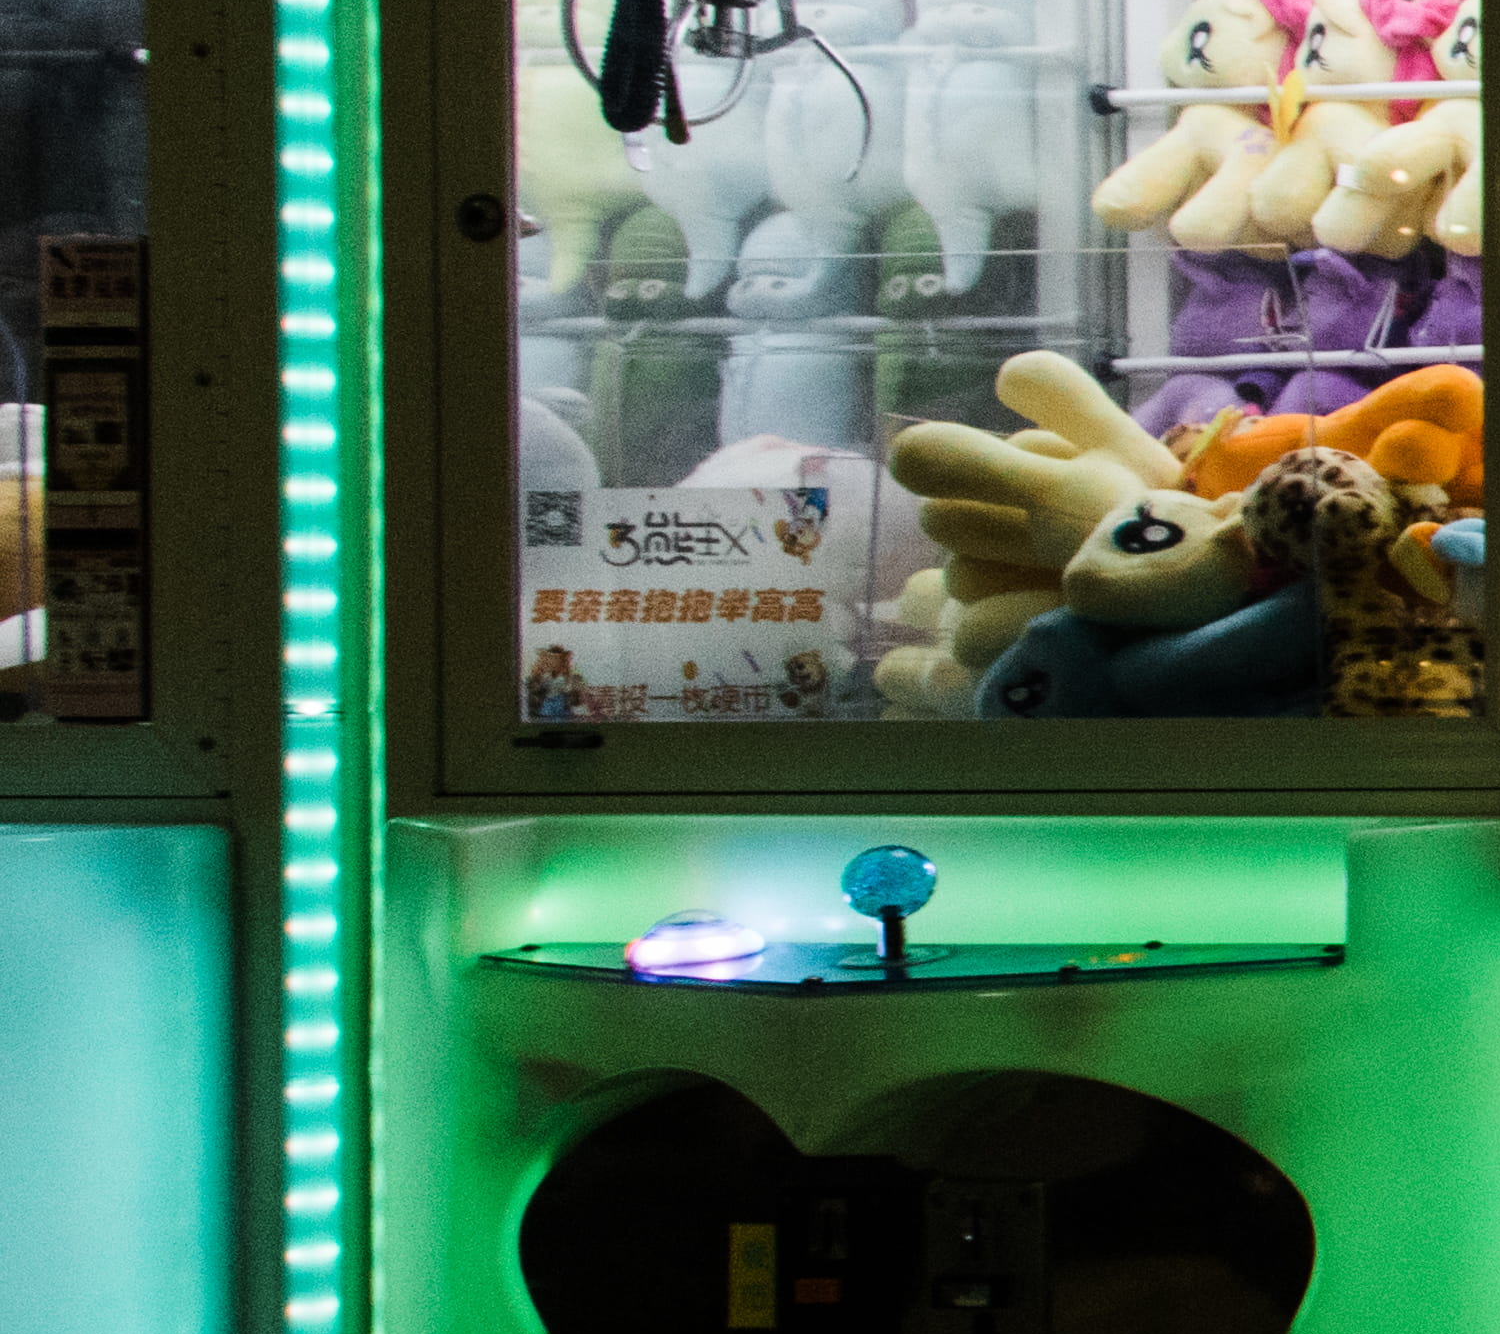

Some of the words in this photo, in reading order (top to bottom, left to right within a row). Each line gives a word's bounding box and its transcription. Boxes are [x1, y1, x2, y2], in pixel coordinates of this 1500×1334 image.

[531, 588, 825, 623] 要亲亲抱抱举高高
